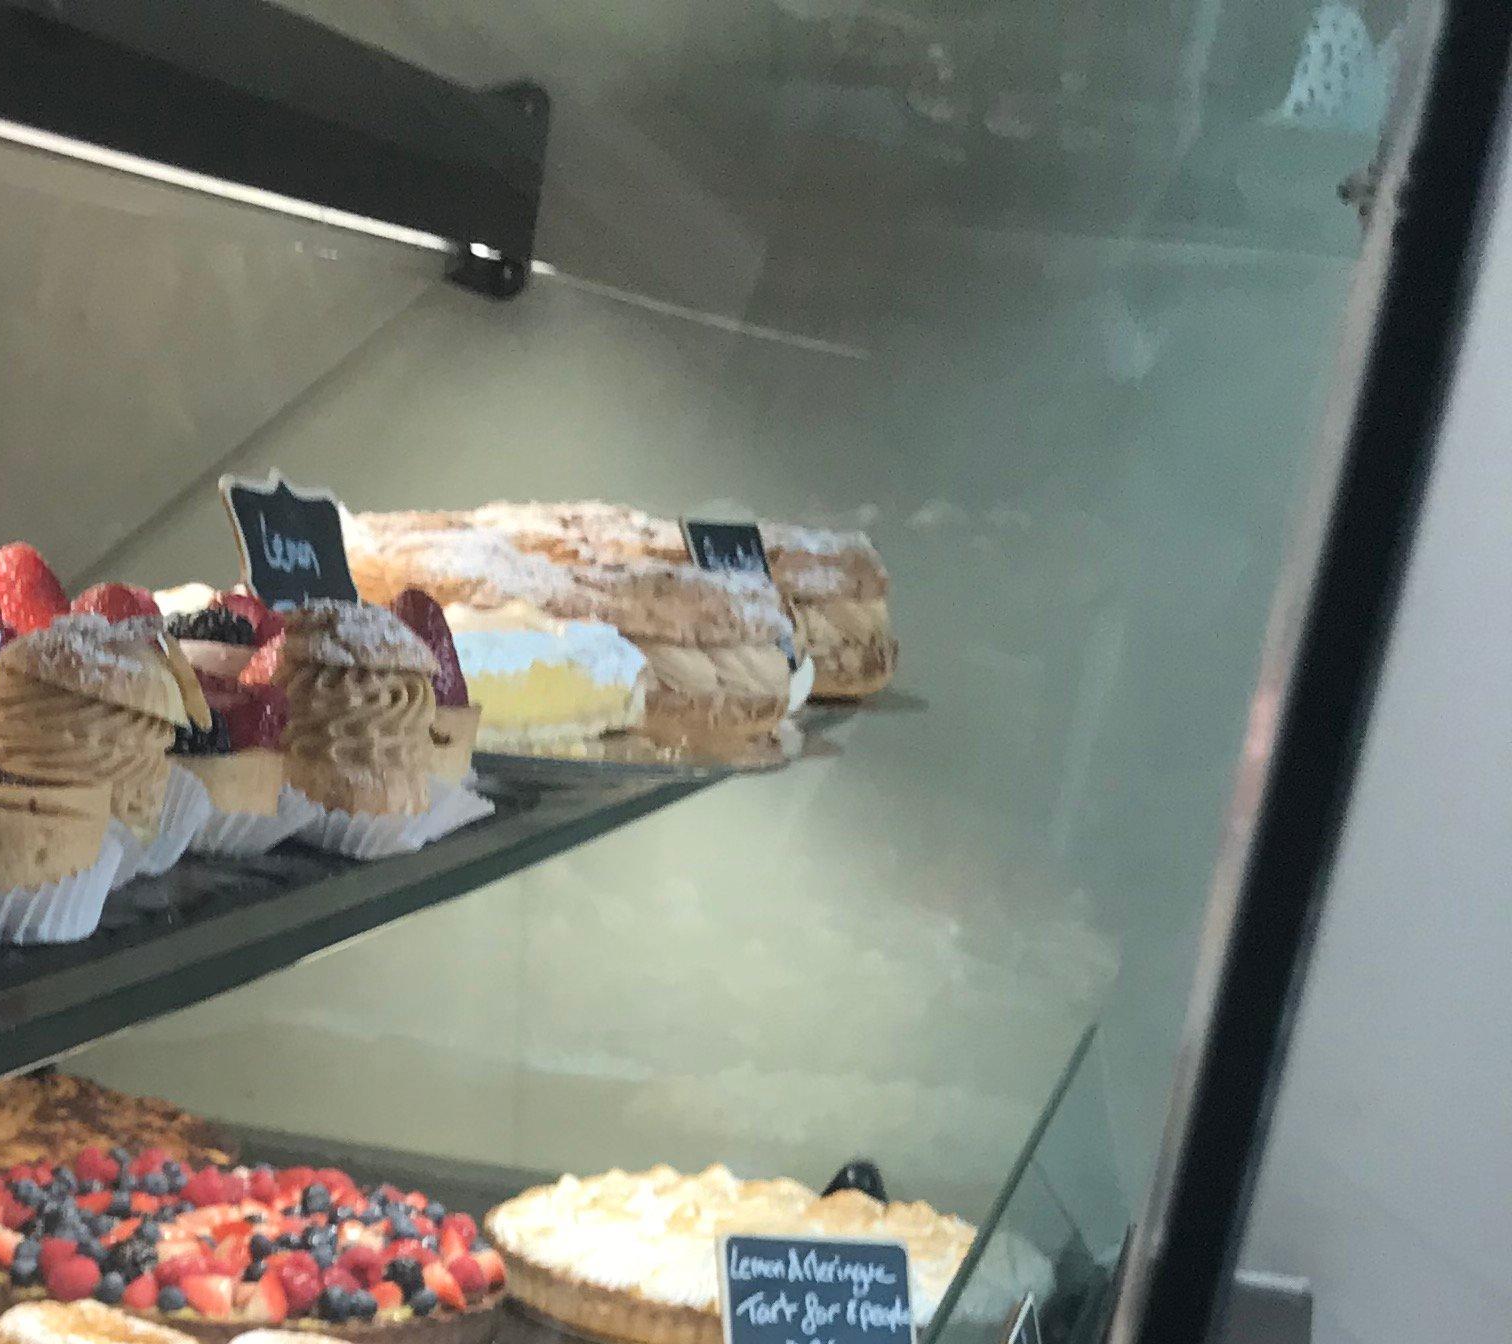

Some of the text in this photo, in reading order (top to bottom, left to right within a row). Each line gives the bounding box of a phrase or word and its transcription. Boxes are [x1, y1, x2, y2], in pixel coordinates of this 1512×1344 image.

[730, 1245, 786, 1281] Lemon
[736, 1290, 800, 1327] Tart
[800, 1290, 842, 1337] for
